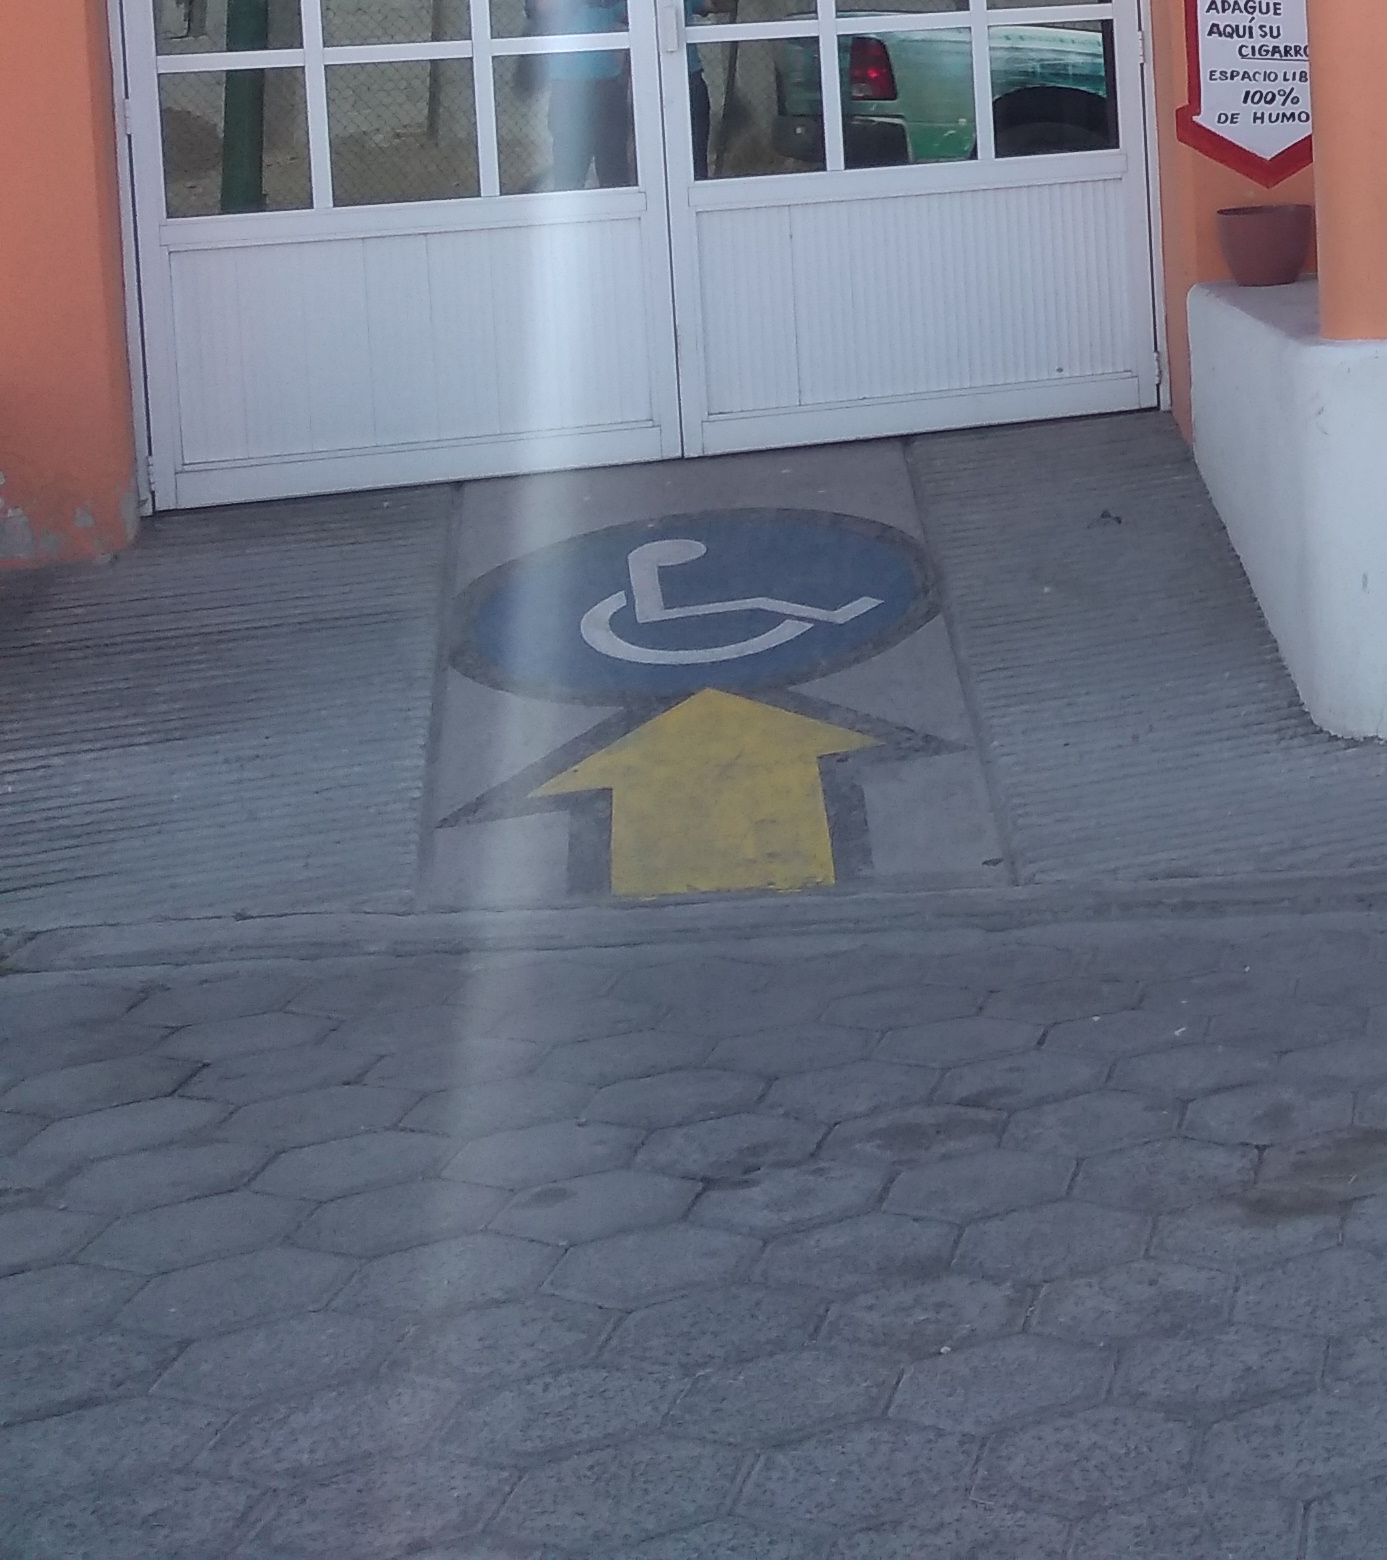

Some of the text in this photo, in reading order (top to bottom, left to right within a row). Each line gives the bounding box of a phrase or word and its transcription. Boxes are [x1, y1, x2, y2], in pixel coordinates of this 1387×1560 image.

[1258, 24, 1282, 40] SU
[1208, 69, 1279, 82] ESPACIO
[1242, 87, 1300, 107] 100%
[1216, 110, 1311, 125] DE HUMO
